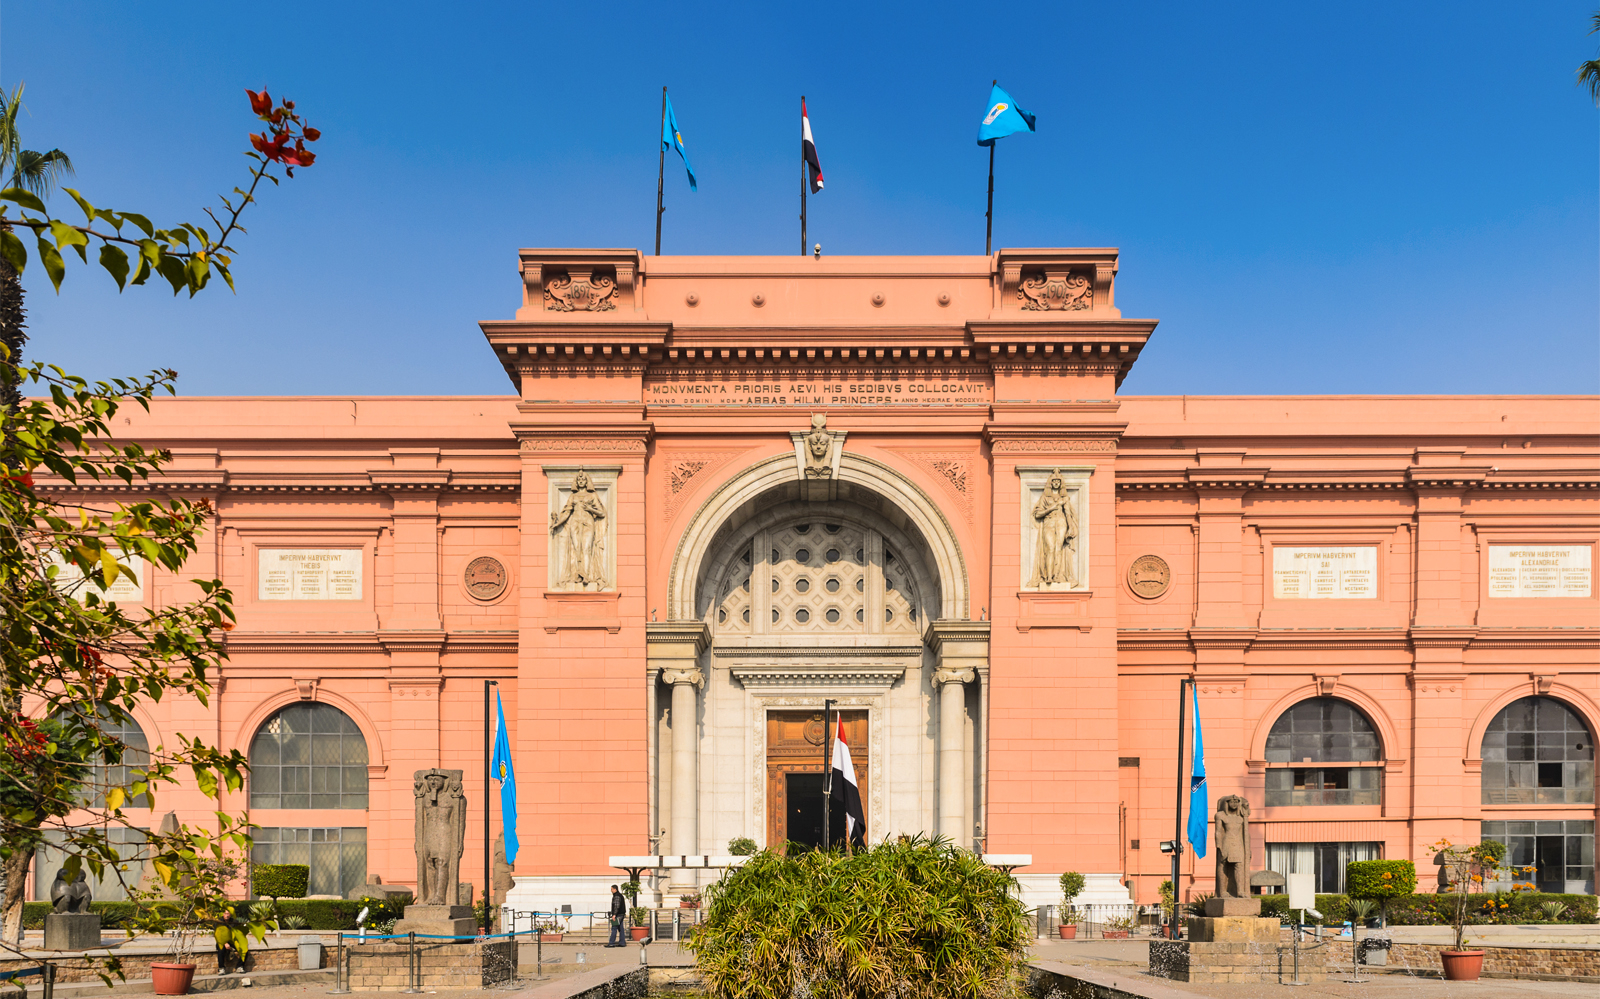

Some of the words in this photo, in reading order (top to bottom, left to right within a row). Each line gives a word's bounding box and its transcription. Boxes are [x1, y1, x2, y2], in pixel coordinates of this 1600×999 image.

[570, 285, 590, 299] 1897
[1046, 284, 1067, 299] 1901
[653, 385, 726, 393] MONVMENTA
[734, 385, 781, 393] PRIORIS
[789, 385, 816, 393] AEVI
[824, 385, 842, 393] HIS
[850, 385, 902, 393] SEDIBVS
[909, 385, 984, 393] COLLOCAVIT
[794, 396, 824, 404] HILMI
[832, 396, 892, 404] PRINCEPS
